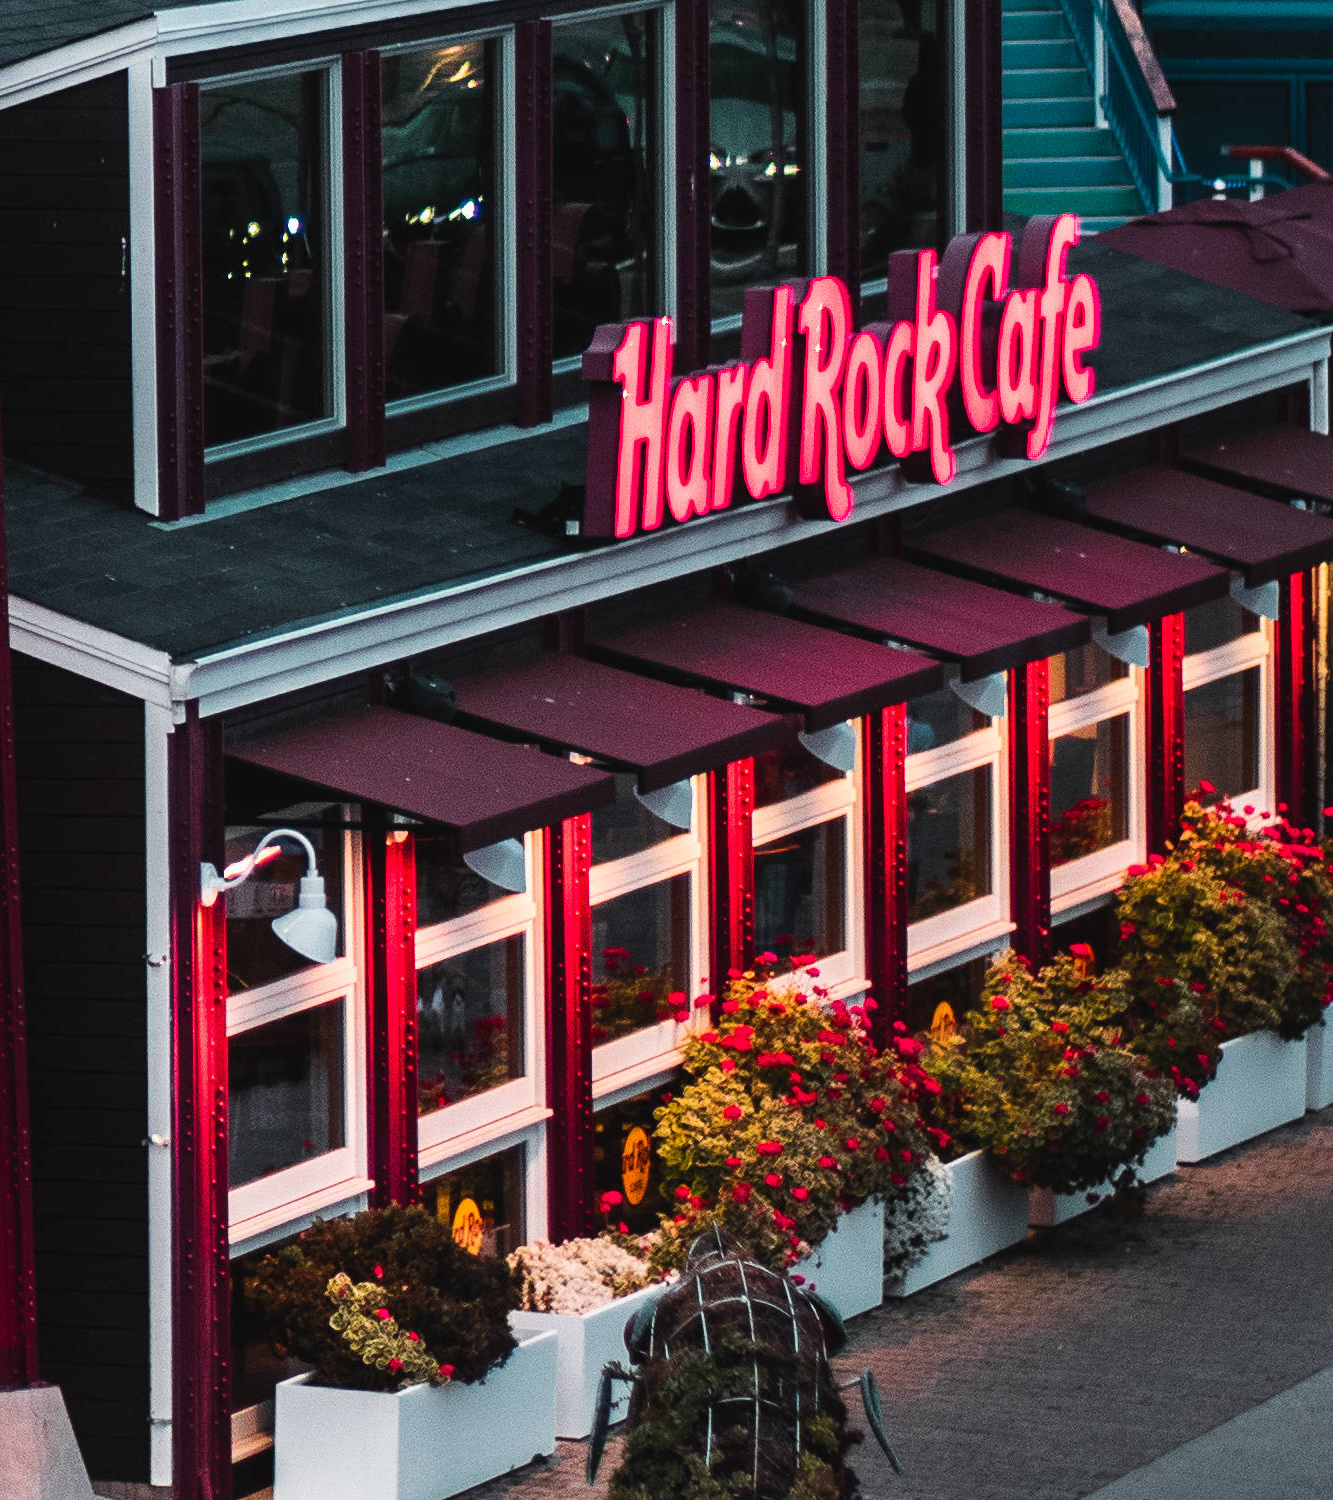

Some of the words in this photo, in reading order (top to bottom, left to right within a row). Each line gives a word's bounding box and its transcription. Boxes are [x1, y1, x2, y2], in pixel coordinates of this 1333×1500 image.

[614, 285, 794, 539] Hard
[798, 248, 958, 523] Rock
[961, 213, 1101, 460] Cafe
